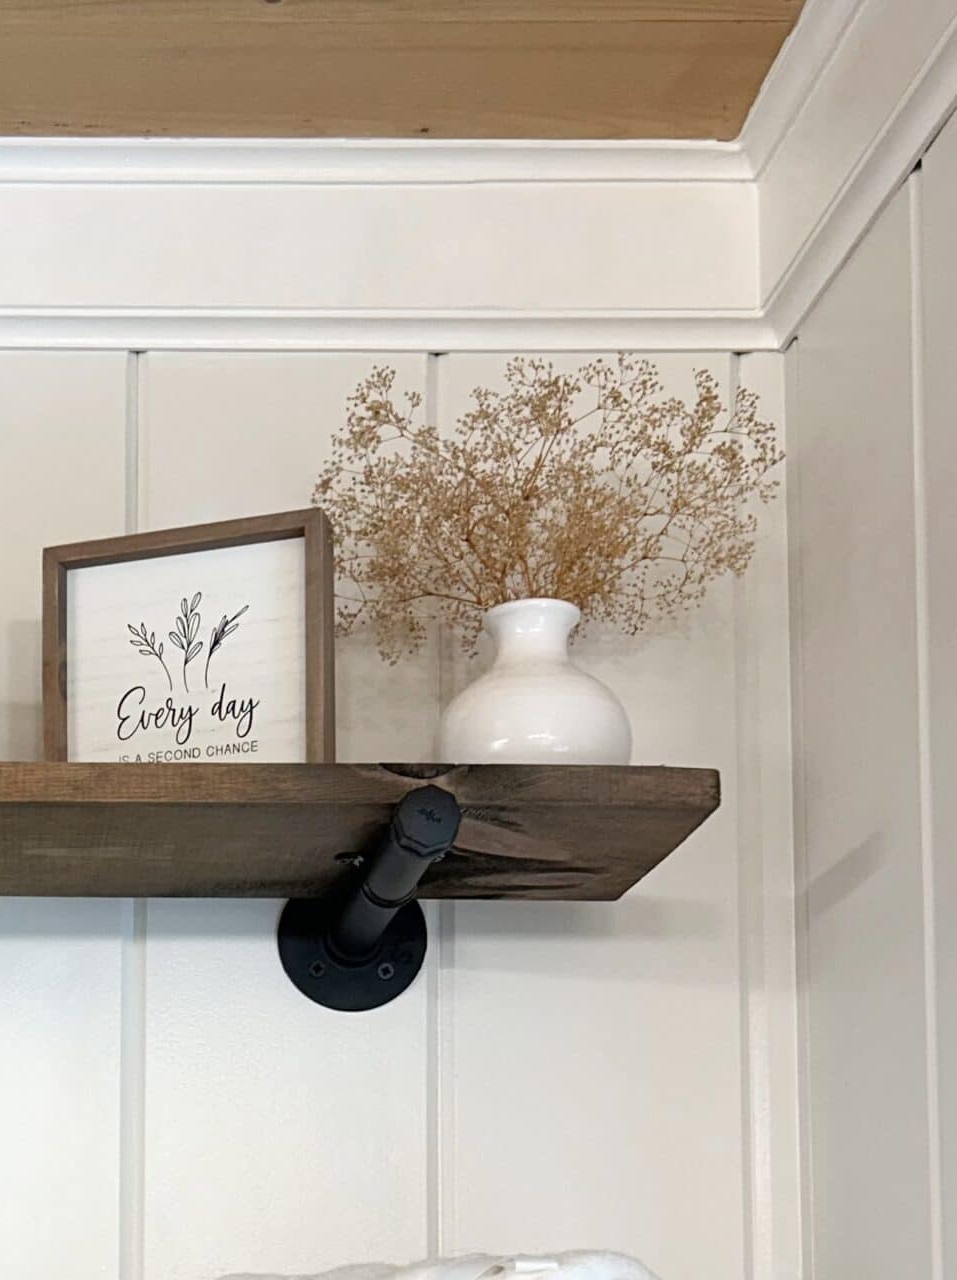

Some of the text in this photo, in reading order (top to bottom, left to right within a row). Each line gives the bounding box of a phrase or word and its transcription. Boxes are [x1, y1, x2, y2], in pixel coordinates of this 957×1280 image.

[116, 683, 260, 745] Every day
[135, 754, 143, 763] A
[147, 747, 202, 763] SECOND
[206, 740, 259, 757] CHANCE
